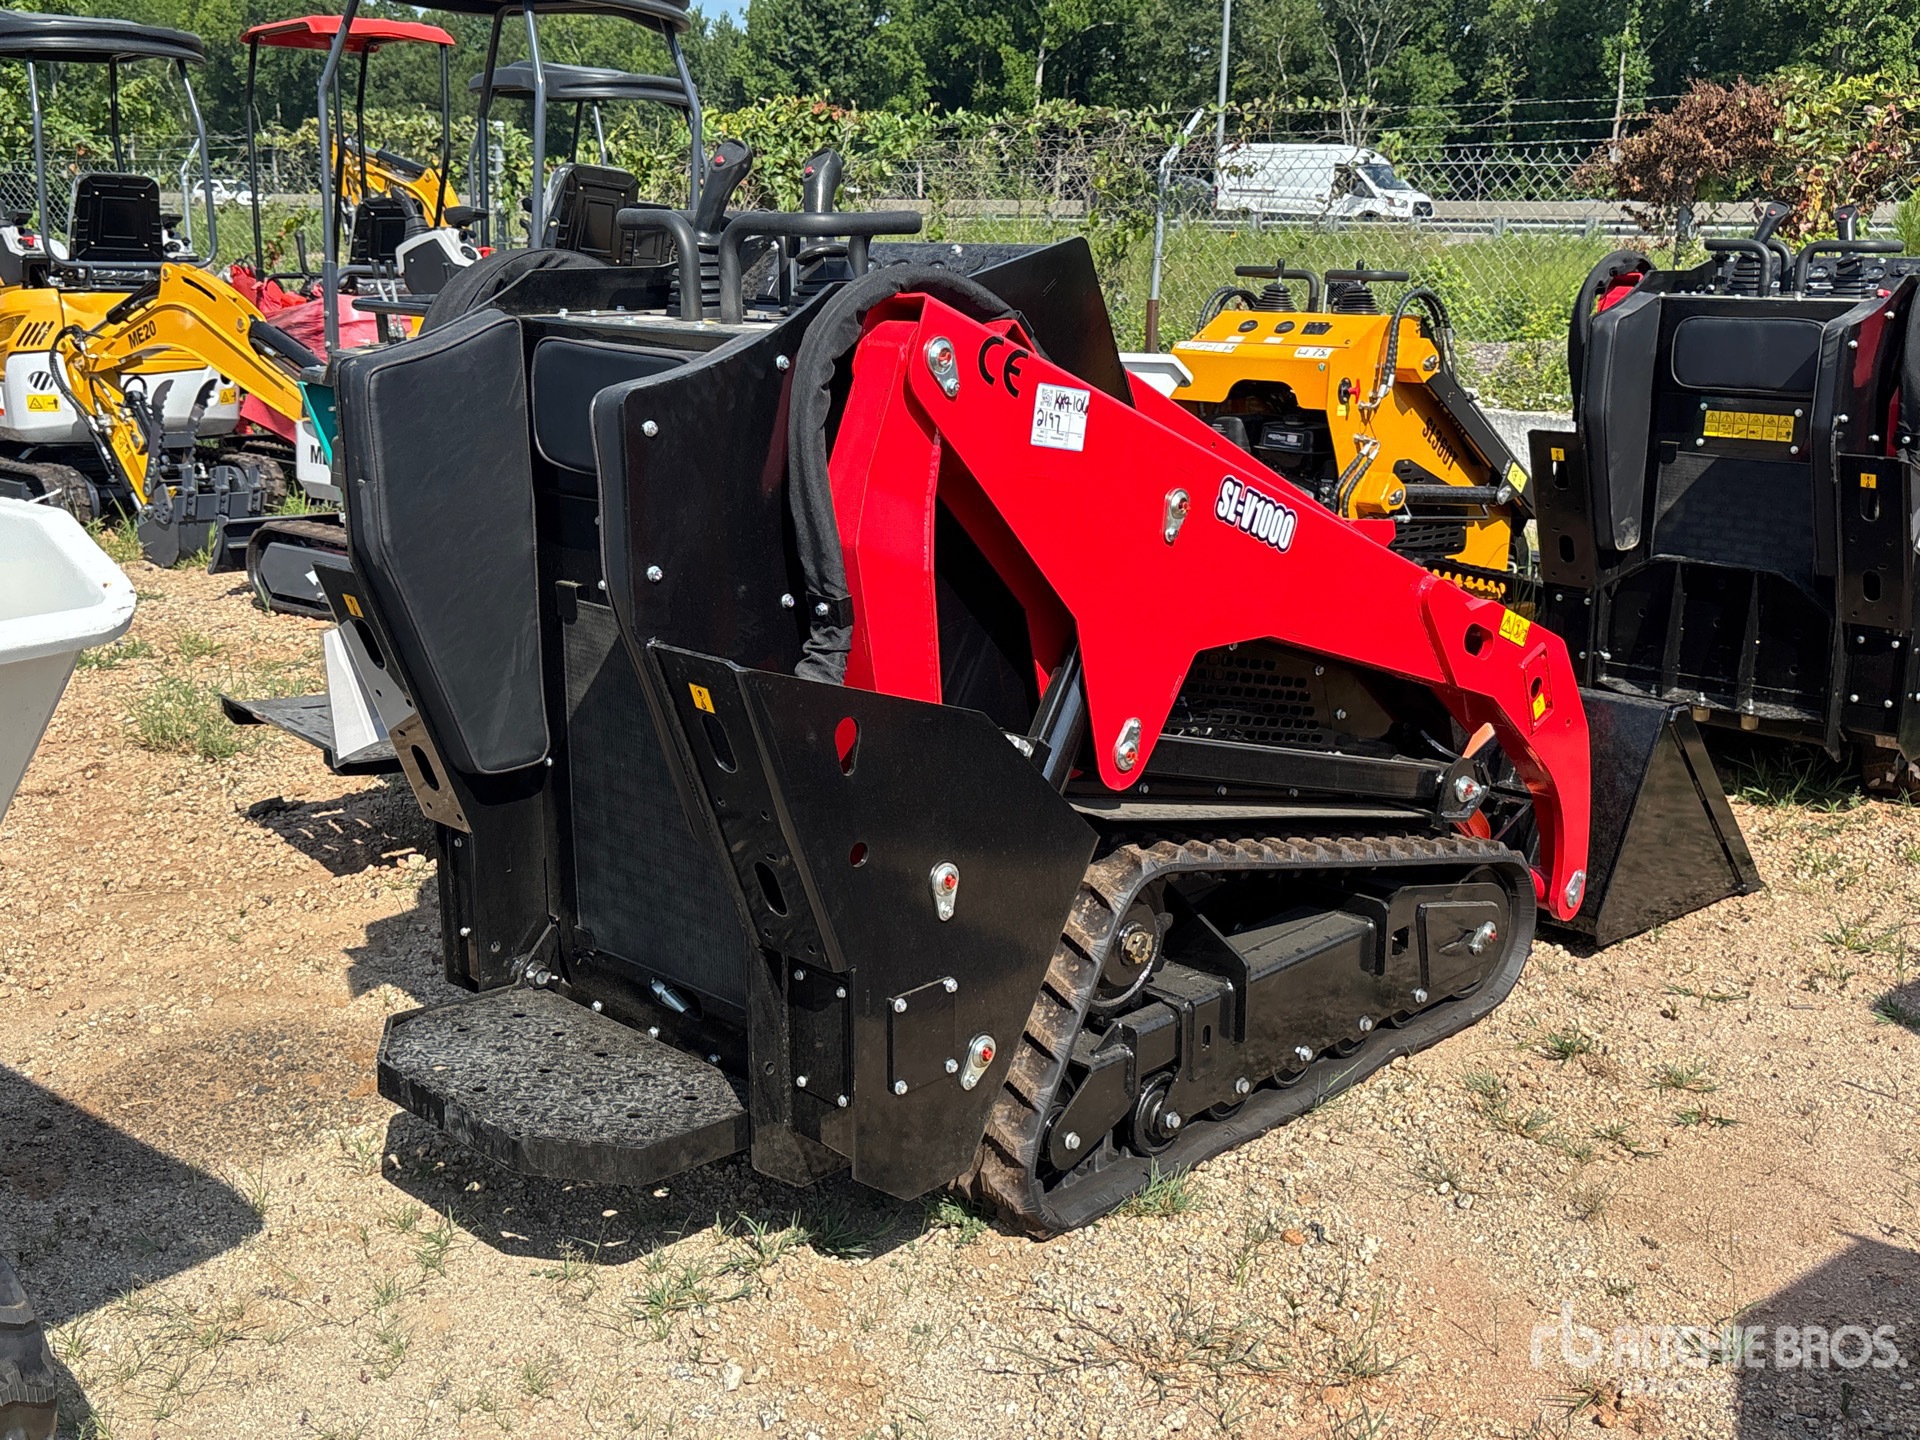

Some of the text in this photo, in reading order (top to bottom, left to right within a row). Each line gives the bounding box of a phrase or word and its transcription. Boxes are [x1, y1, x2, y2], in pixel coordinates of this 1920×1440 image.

[127, 320, 157, 350] ME20
[978, 335, 1029, 399] CE
[1216, 479, 1296, 551] SL-V1000
